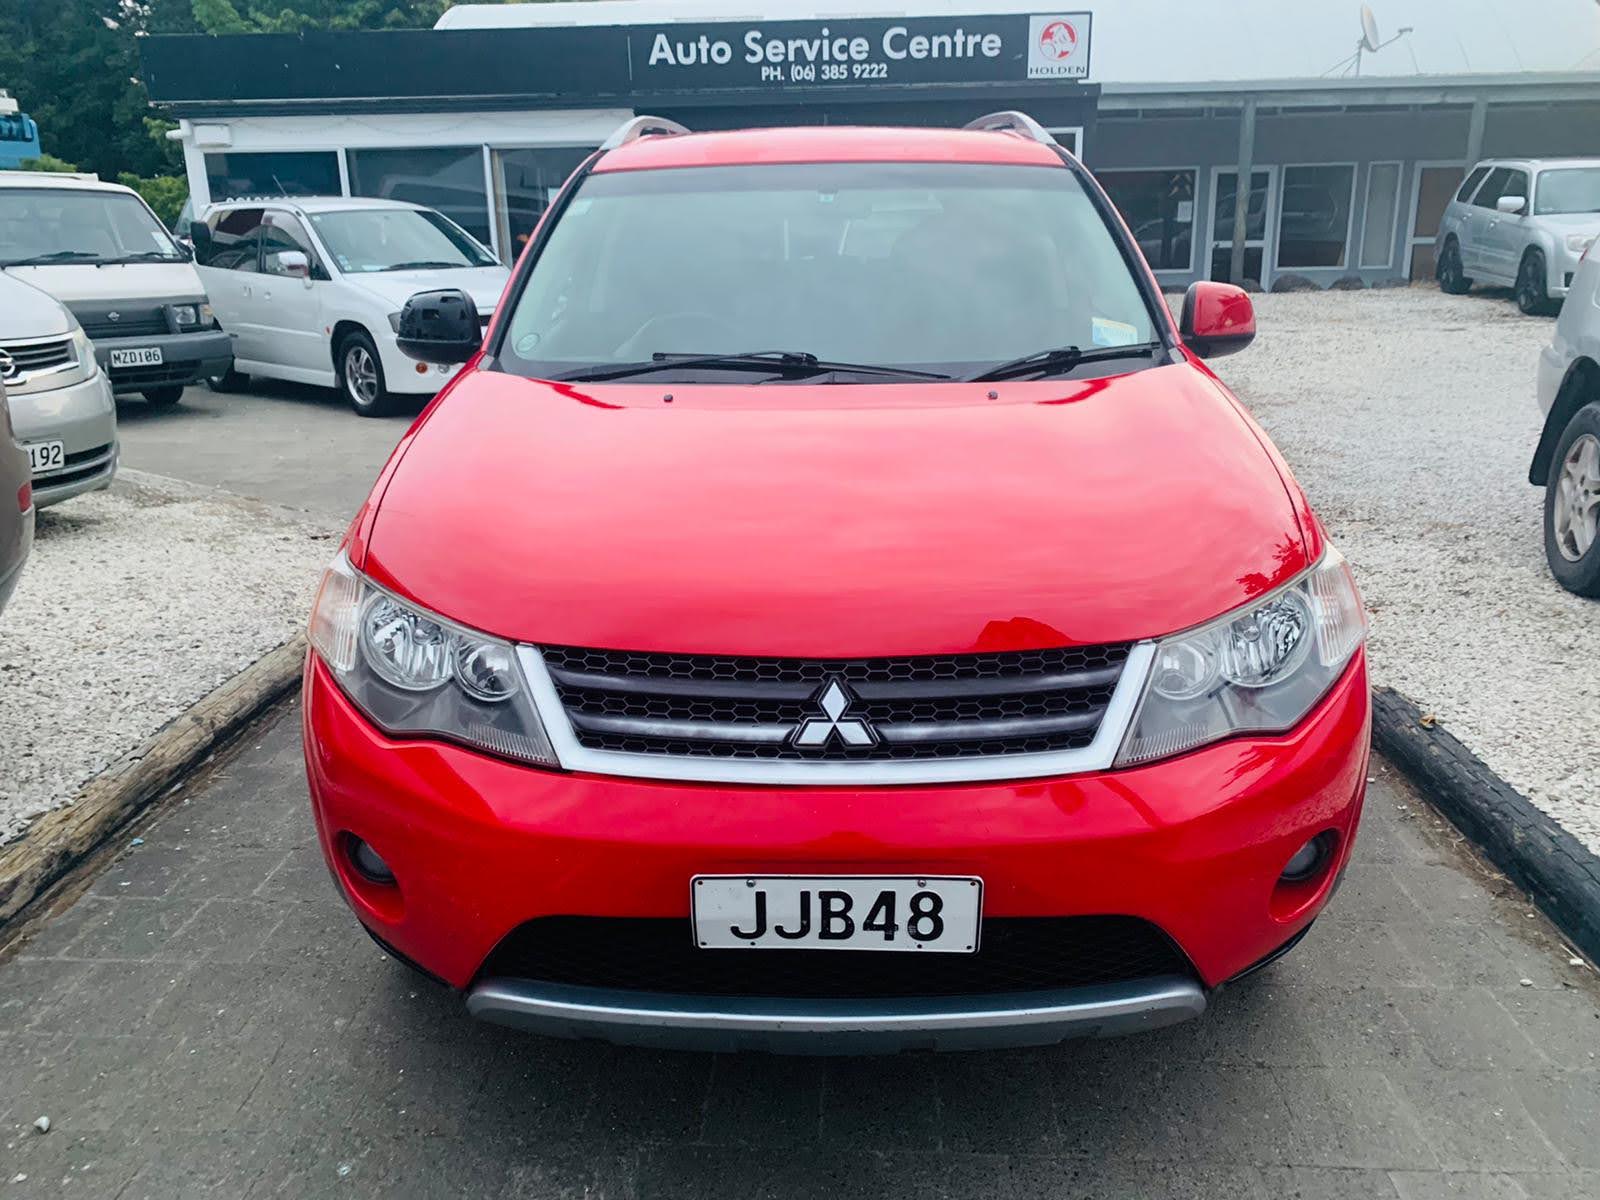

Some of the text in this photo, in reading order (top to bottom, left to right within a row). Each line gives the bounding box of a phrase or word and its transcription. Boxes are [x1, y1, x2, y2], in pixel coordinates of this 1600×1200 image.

[648, 26, 1002, 66] Auto Service Centre
[761, 63, 888, 82] PH. (06) 385 9222
[1029, 65, 1086, 75] HOLDEN
[730, 890, 944, 942] JJB48
